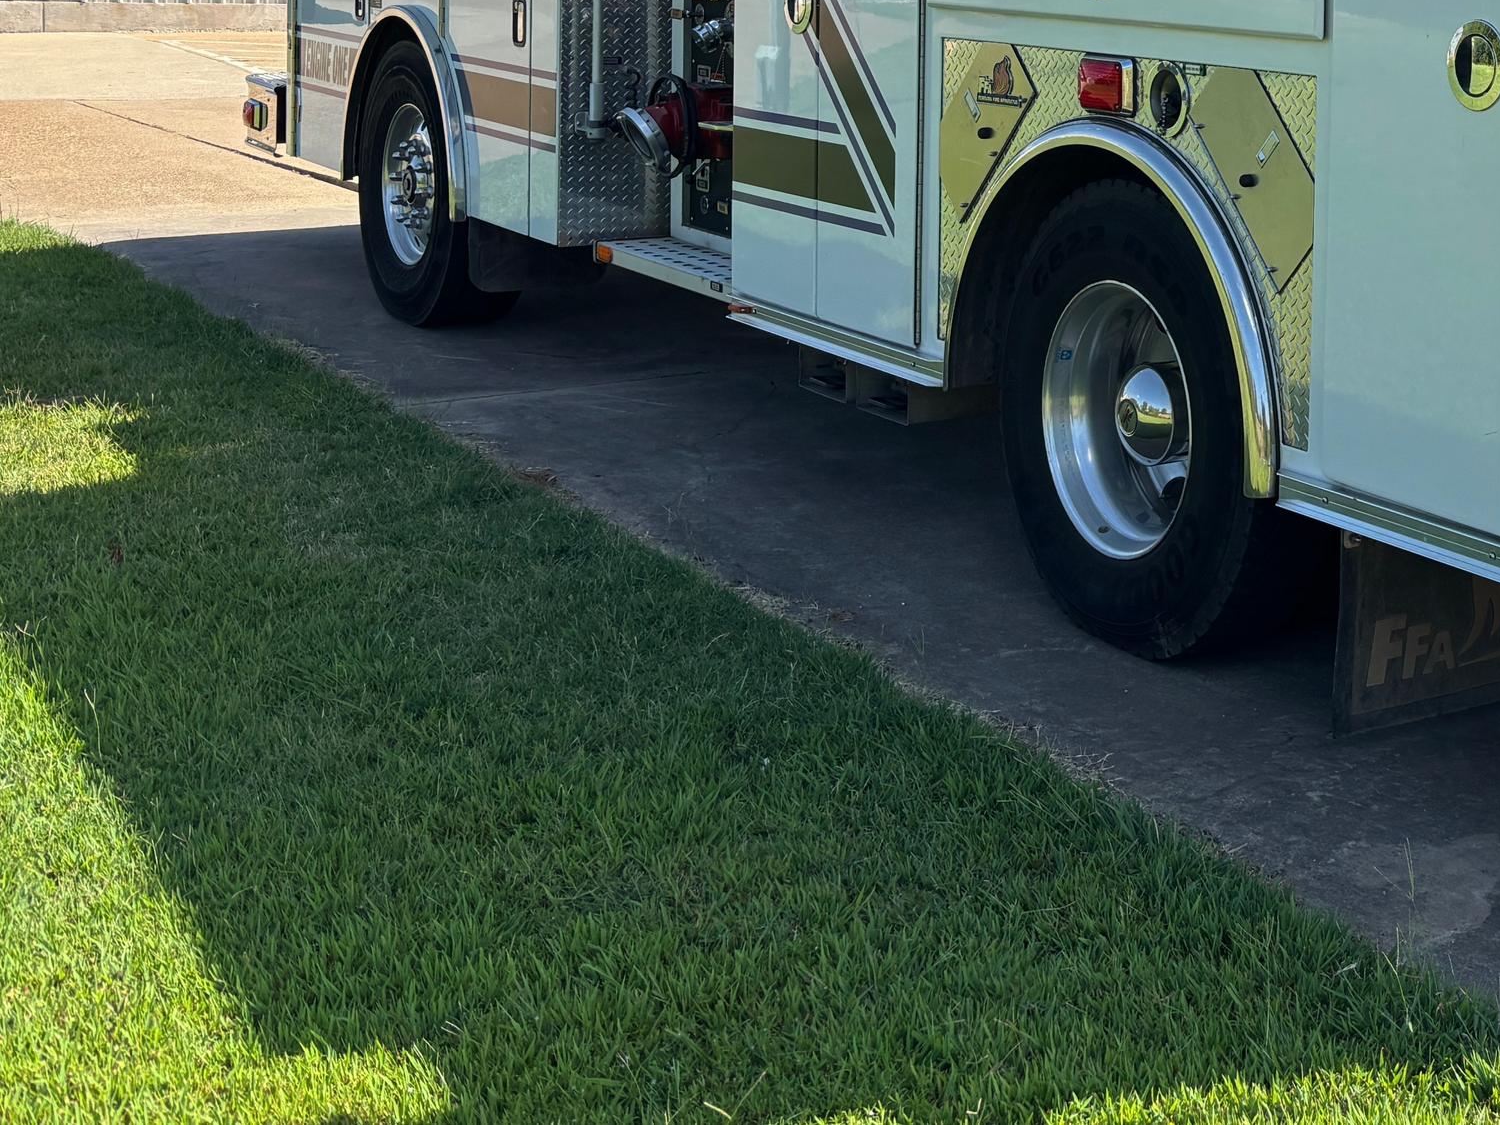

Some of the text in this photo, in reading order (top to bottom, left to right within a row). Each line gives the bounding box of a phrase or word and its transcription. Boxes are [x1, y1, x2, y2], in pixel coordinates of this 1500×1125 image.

[307, 39, 348, 87] ENGINE ONE
[1366, 613, 1457, 688] FFA
